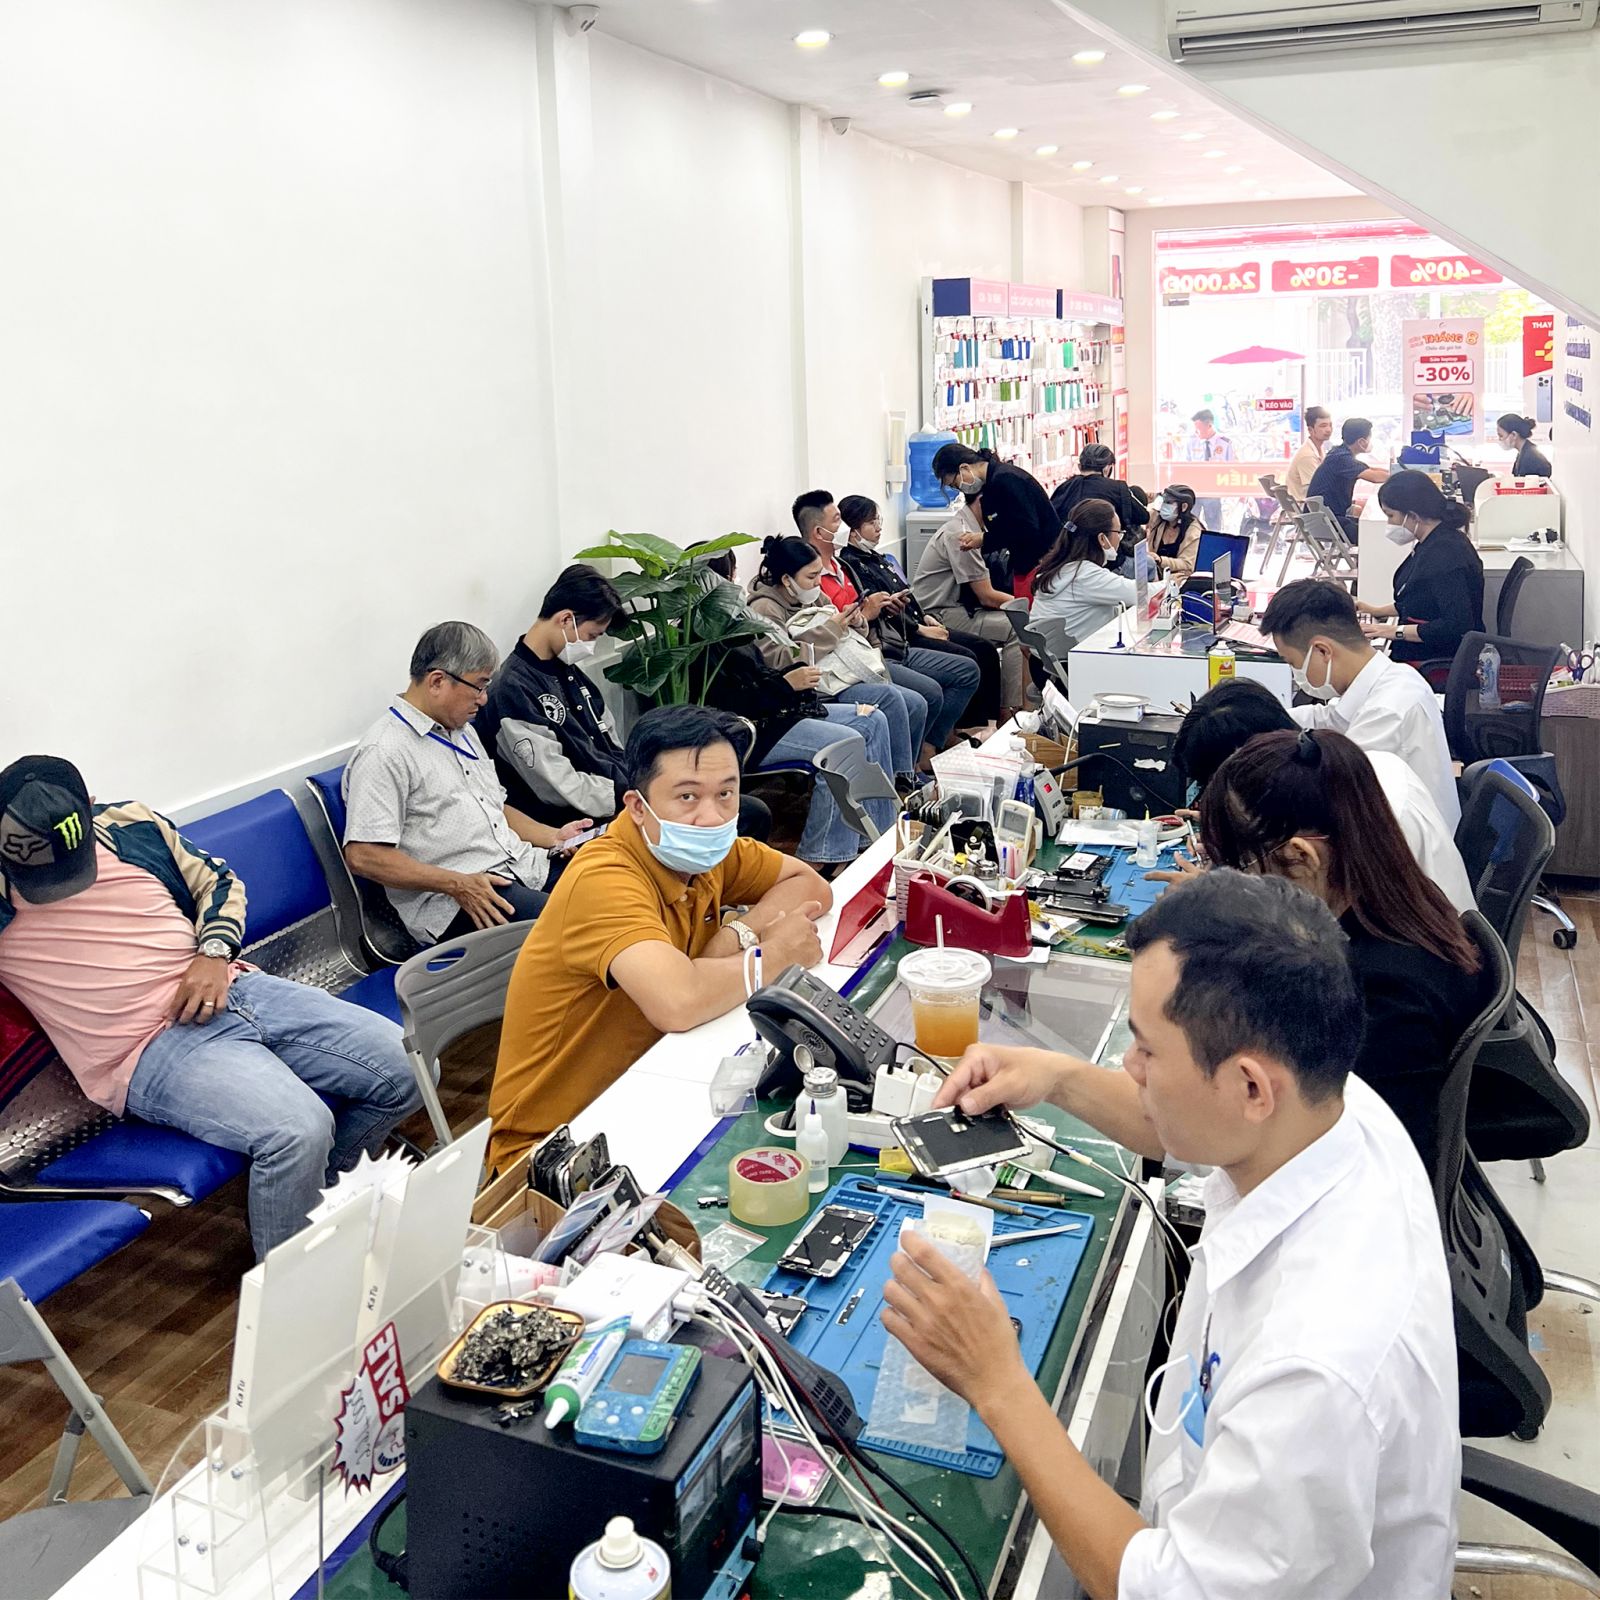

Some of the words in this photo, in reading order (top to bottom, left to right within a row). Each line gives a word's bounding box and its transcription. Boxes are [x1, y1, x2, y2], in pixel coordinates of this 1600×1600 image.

[1423, 331, 1463, 344] THÁNG
[1466, 330, 1479, 345] 8
[1417, 366, 1470, 382] -30%
[1279, 401, 1293, 409] VÀO
[366, 1325, 405, 1417] SALE
